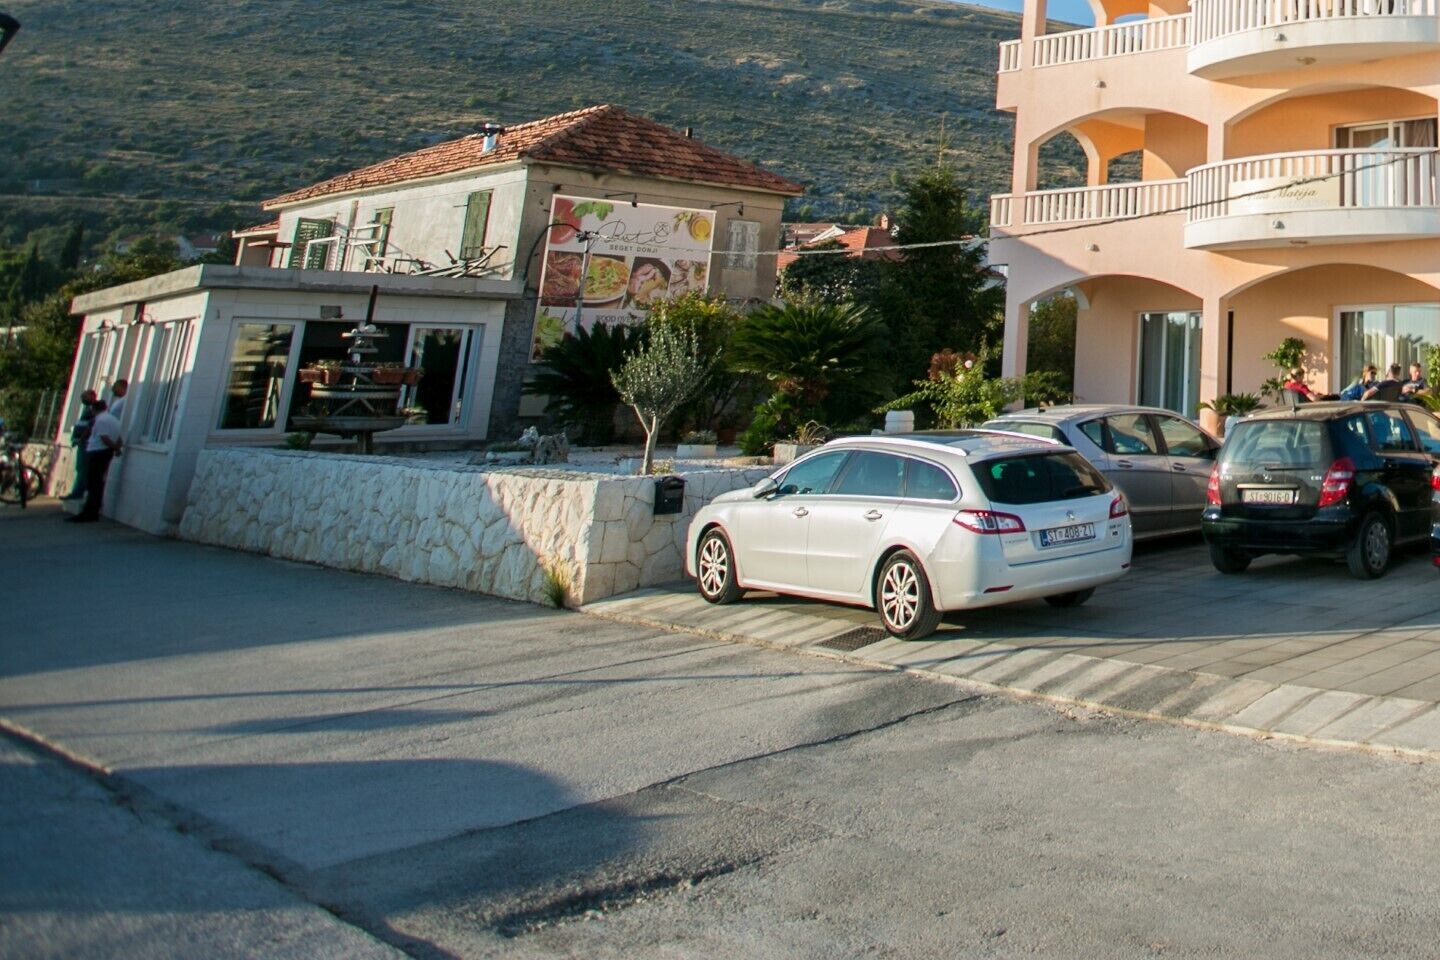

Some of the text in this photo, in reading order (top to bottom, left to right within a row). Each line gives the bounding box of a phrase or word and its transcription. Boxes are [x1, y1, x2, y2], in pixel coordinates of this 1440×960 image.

[1274, 186, 1317, 200] Matija
[609, 244, 633, 252] SEGET
[1048, 530, 1057, 541] ST
